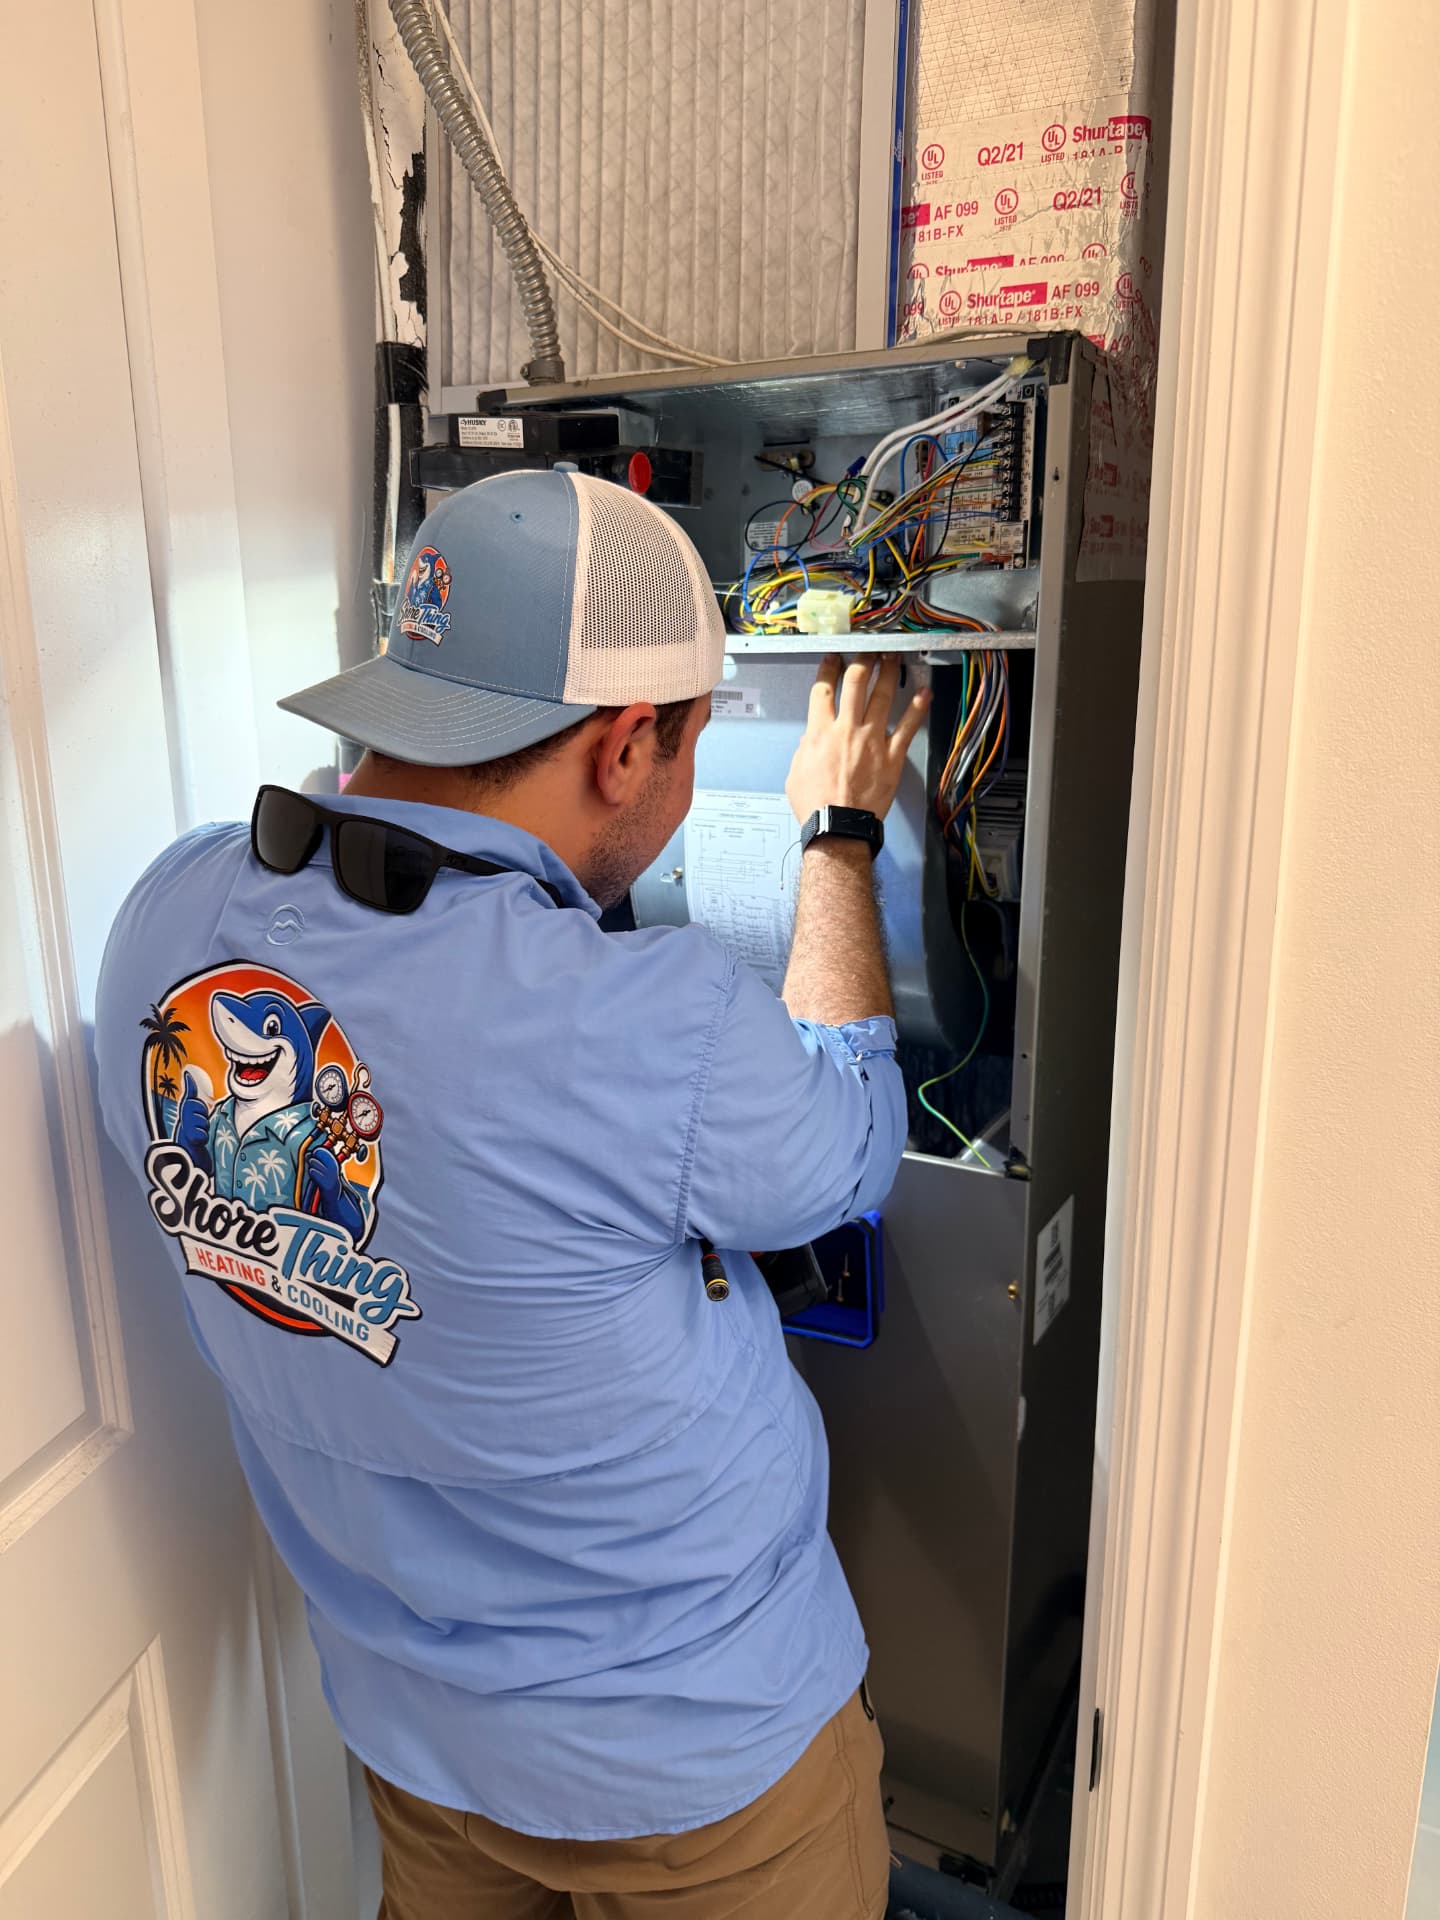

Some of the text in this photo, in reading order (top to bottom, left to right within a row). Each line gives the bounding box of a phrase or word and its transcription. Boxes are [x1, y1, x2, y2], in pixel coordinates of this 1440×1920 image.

[1072, 120, 1144, 143] Shurtape
[977, 141, 1024, 167] Q2/21
[1041, 152, 1065, 163] LISTED
[921, 170, 944, 181] LISTED
[934, 204, 952, 221] AF
[955, 200, 979, 218] 099
[1053, 186, 1102, 212] Q2/21
[994, 215, 1017, 226] LISTED
[967, 281, 1100, 309] Shurtape AF 099
[1027, 304, 1083, 322] 181B-FX
[154, 1151, 415, 1324] Shore Thing
[195, 1247, 369, 1342] HEATING & COOLING
